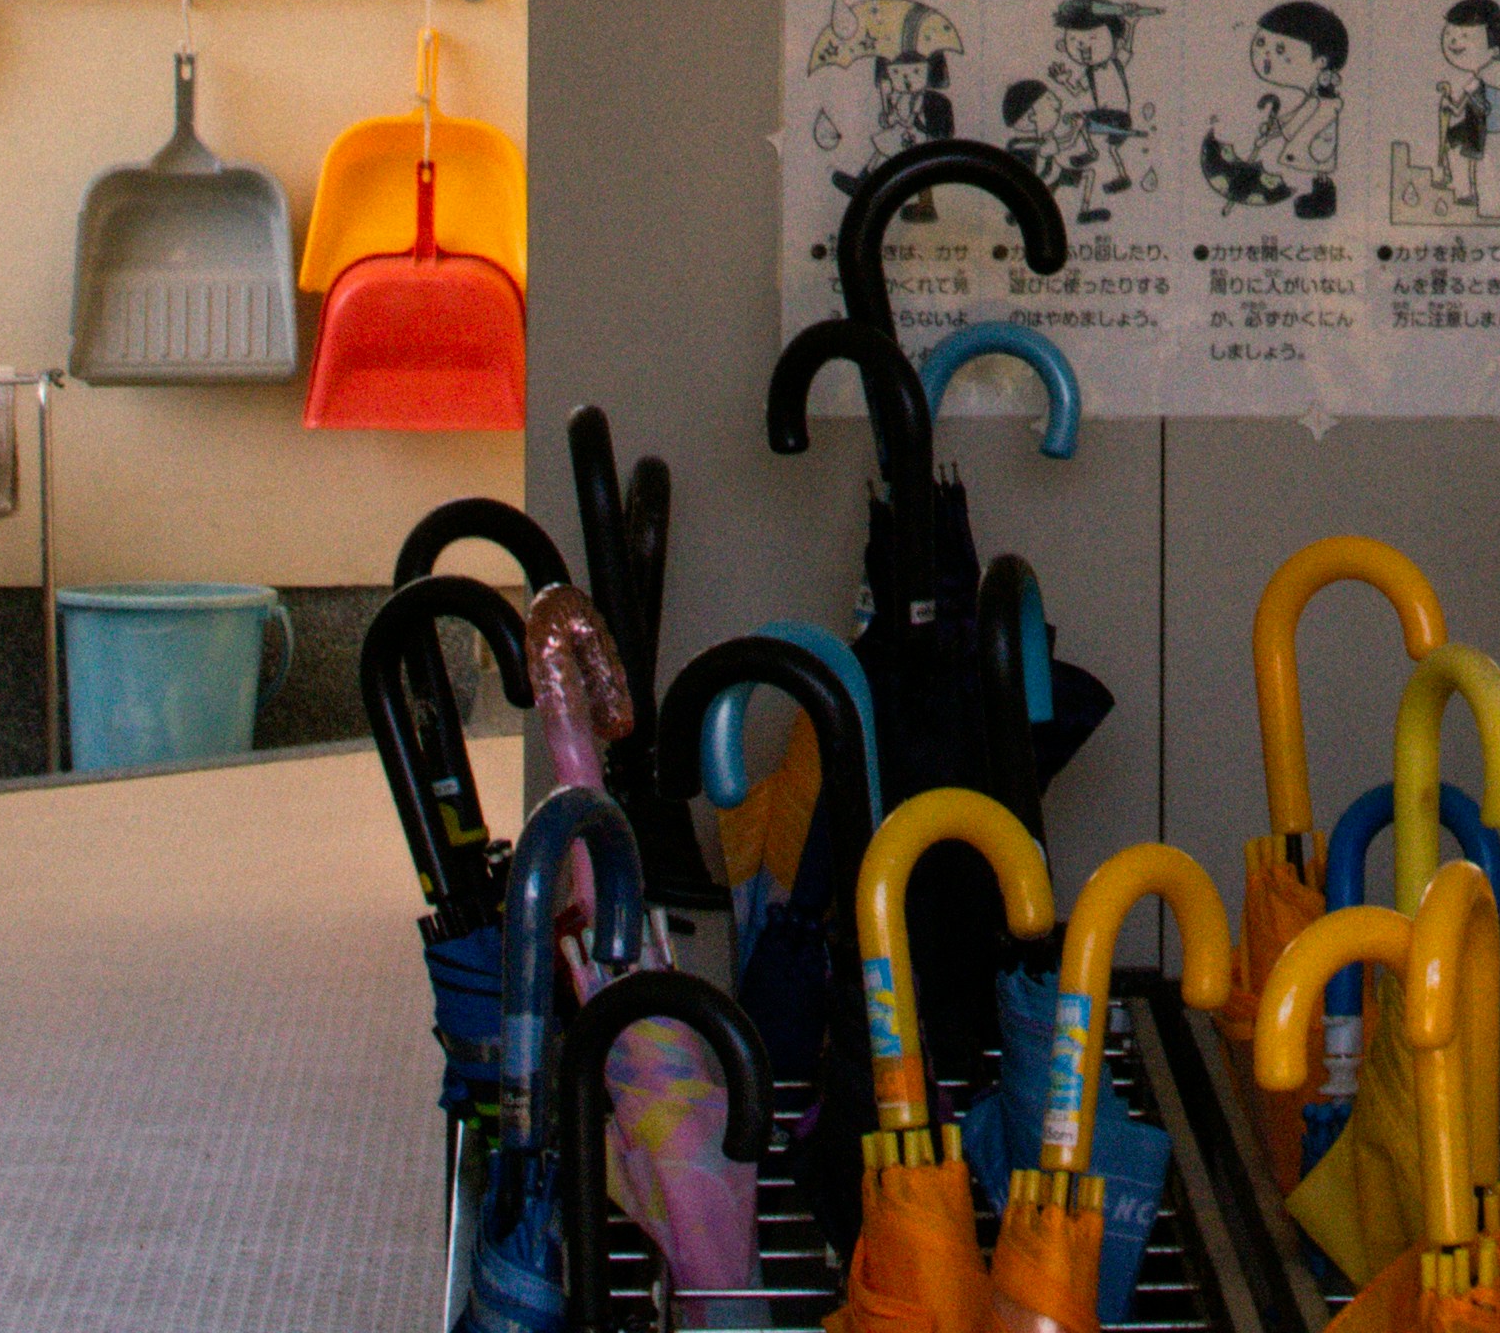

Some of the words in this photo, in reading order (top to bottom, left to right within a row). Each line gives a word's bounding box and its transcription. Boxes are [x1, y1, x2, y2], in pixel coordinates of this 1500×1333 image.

[1210, 341, 1306, 361] しましょう。
